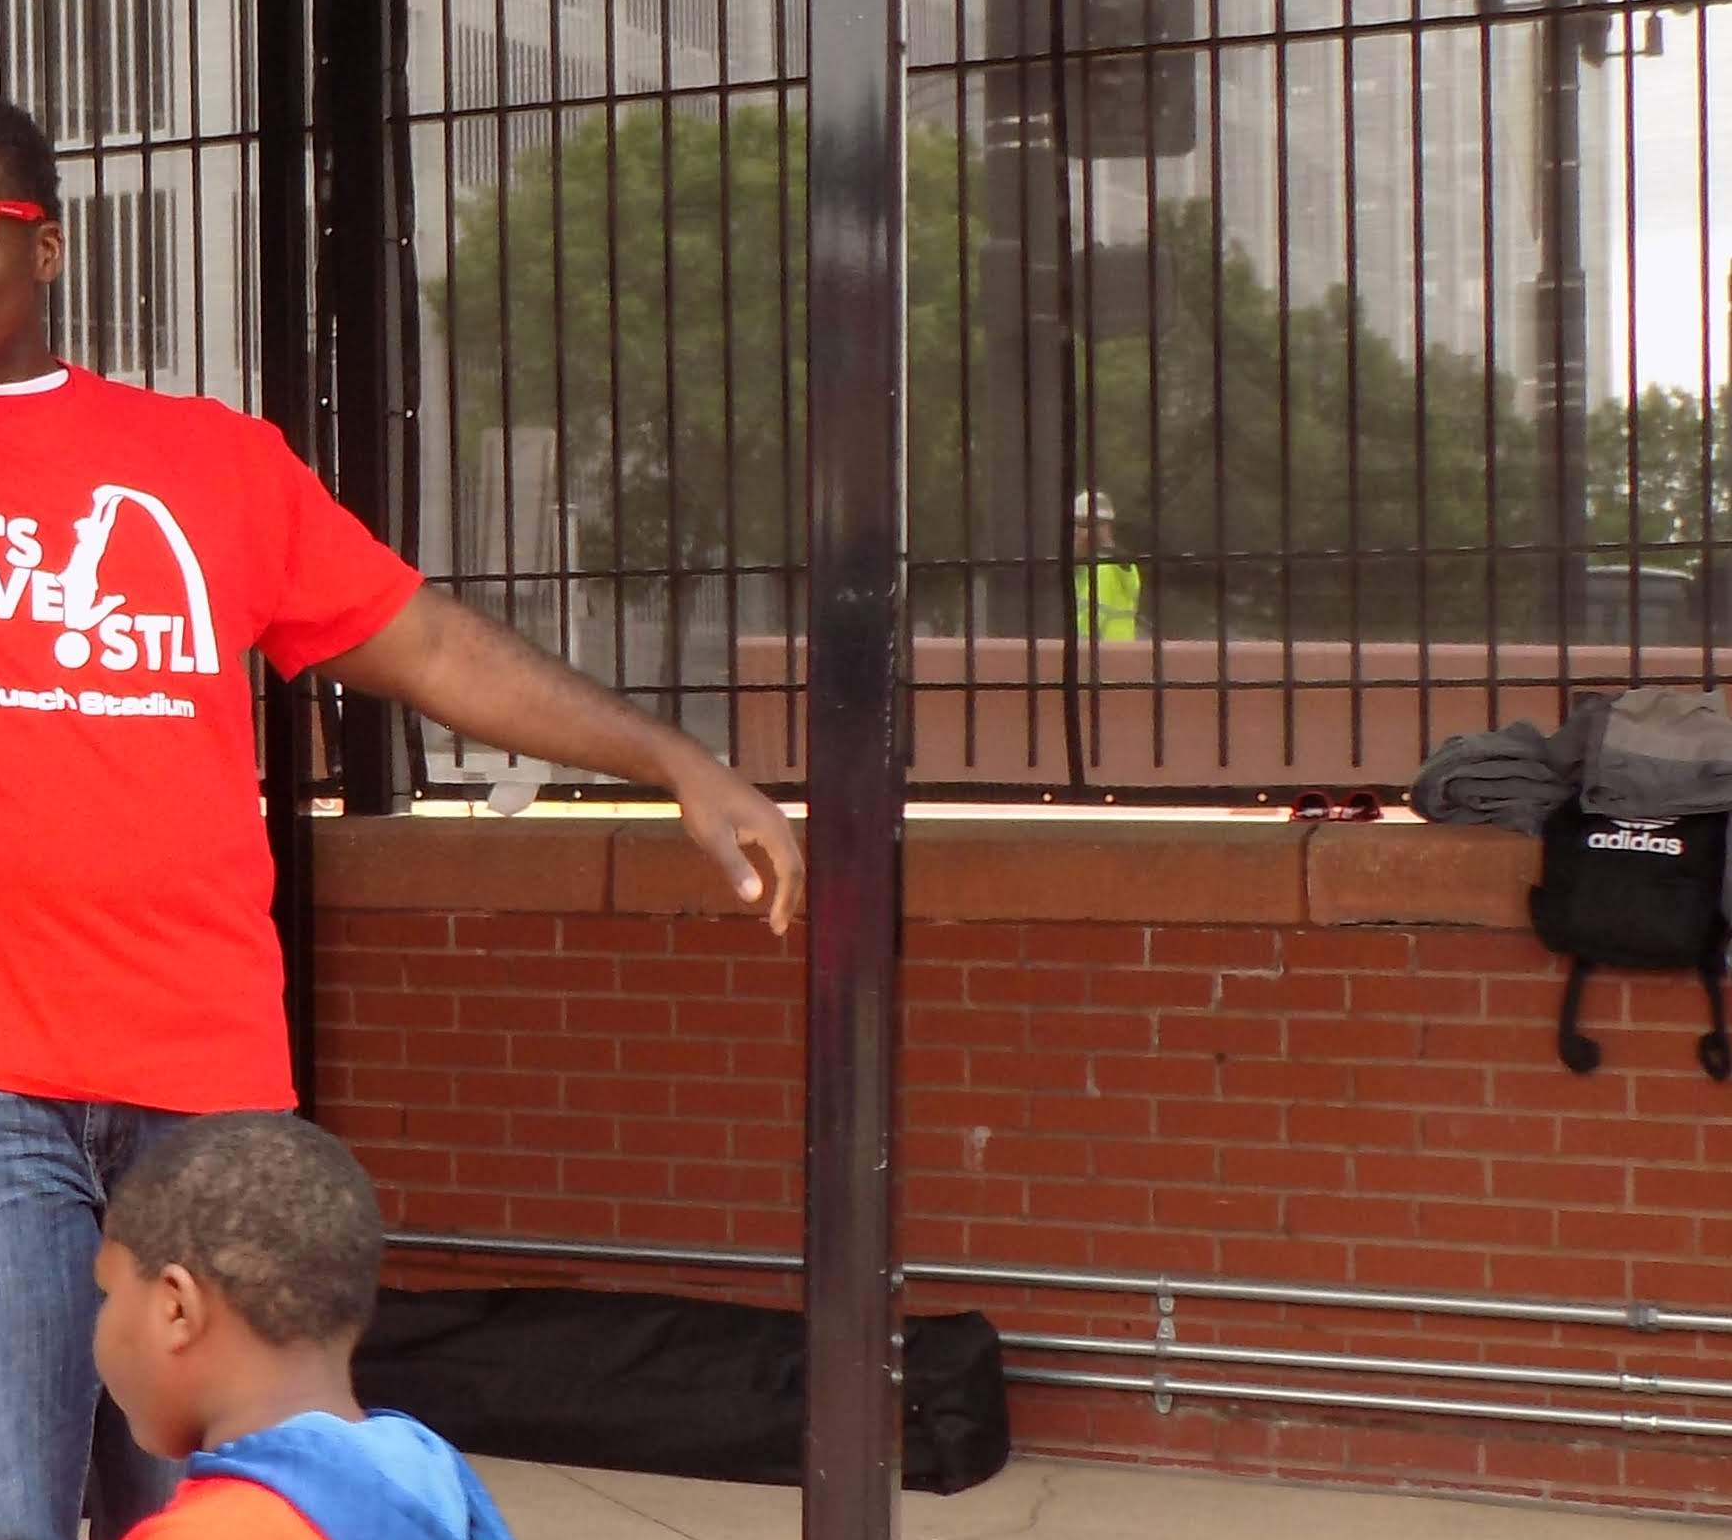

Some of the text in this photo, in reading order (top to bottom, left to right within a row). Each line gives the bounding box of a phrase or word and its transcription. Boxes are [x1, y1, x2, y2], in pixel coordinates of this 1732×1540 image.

[99, 613, 196, 673] STL
[78, 690, 195, 718] Stadium
[1587, 829, 1684, 856] adidas
